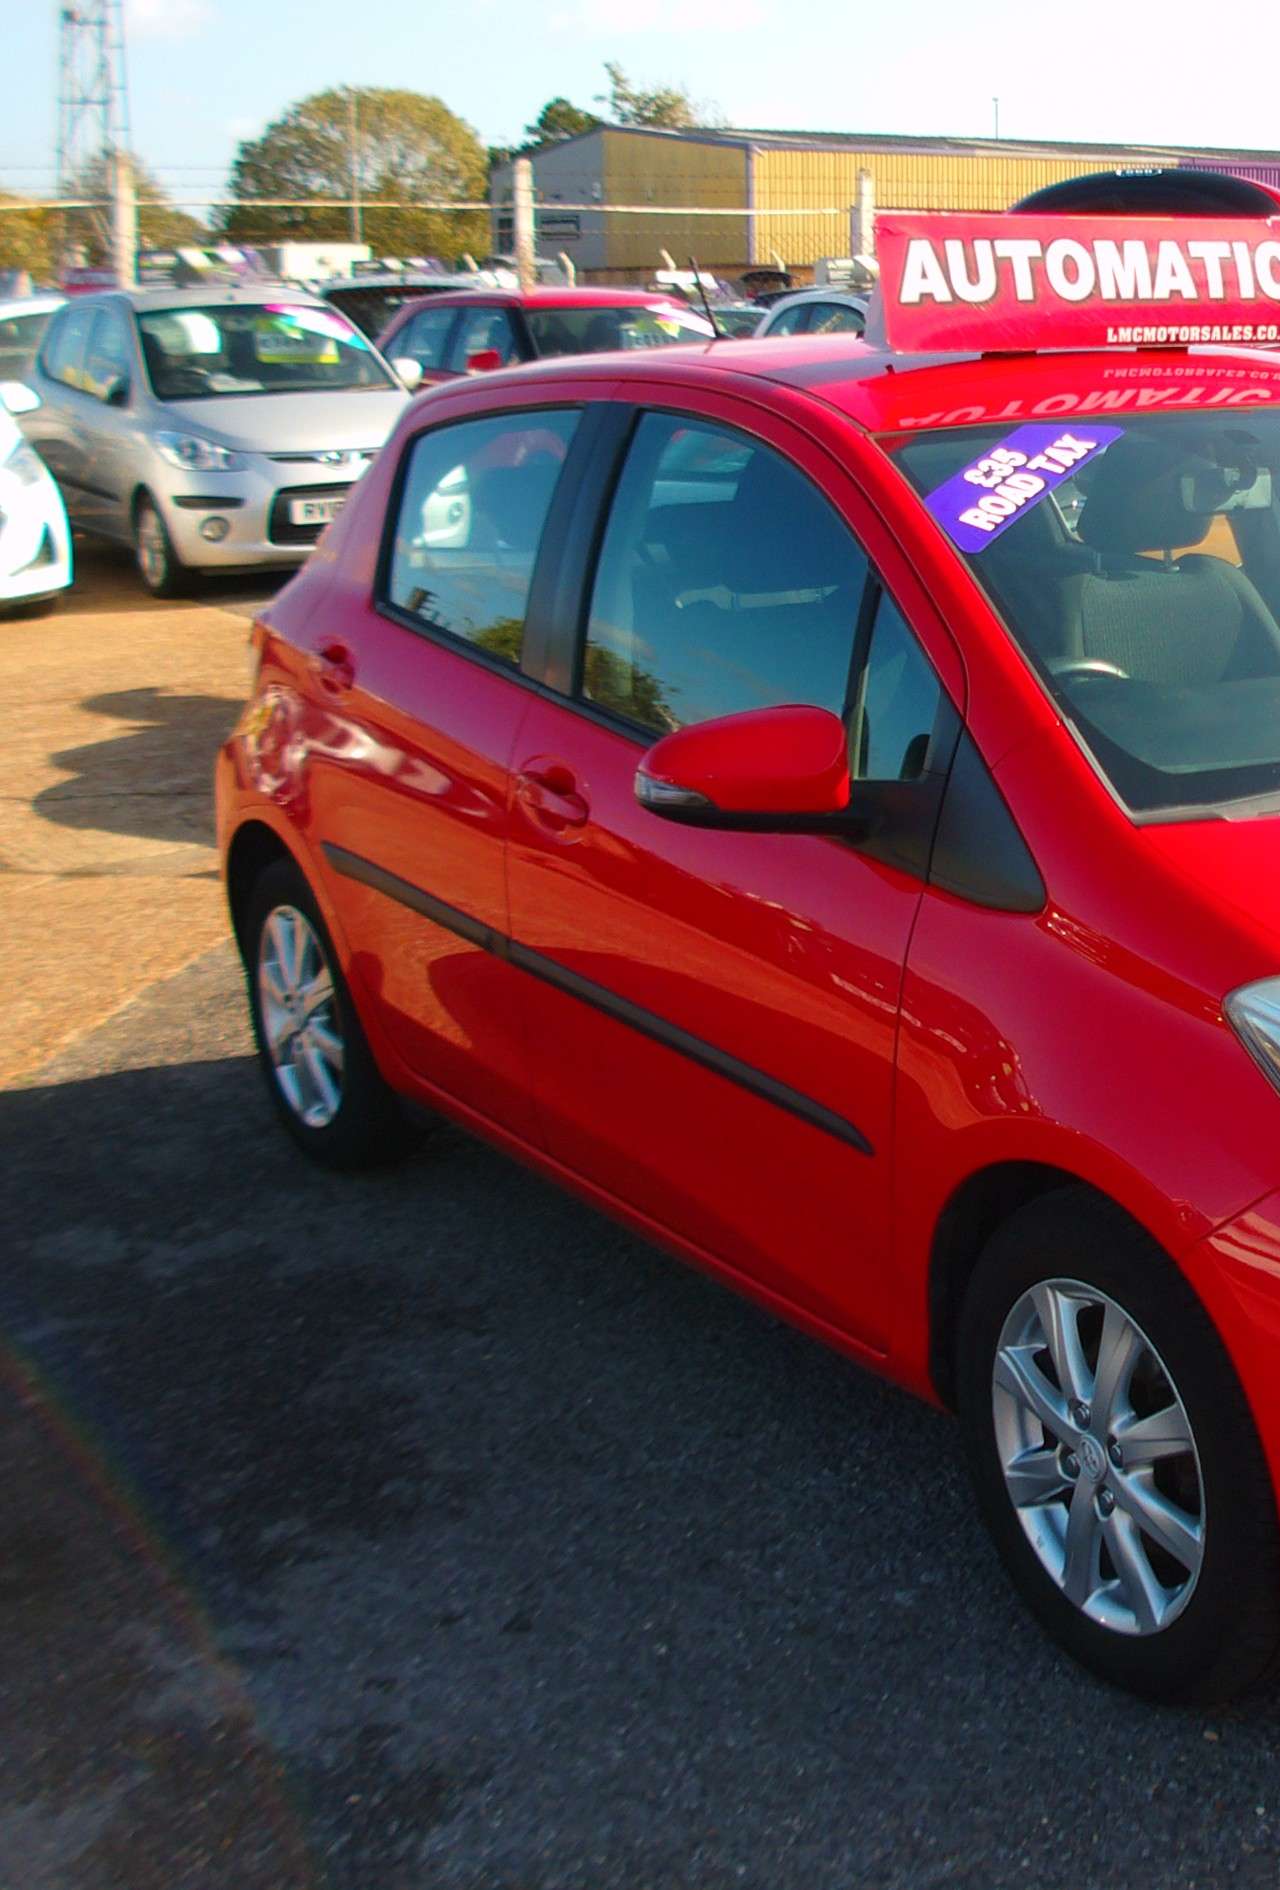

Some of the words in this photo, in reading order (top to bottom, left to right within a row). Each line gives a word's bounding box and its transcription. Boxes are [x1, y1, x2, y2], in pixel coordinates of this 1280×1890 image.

[959, 473, 1046, 533] ROAD
[1026, 433, 1098, 475] TAX
[963, 447, 1028, 489] £35
